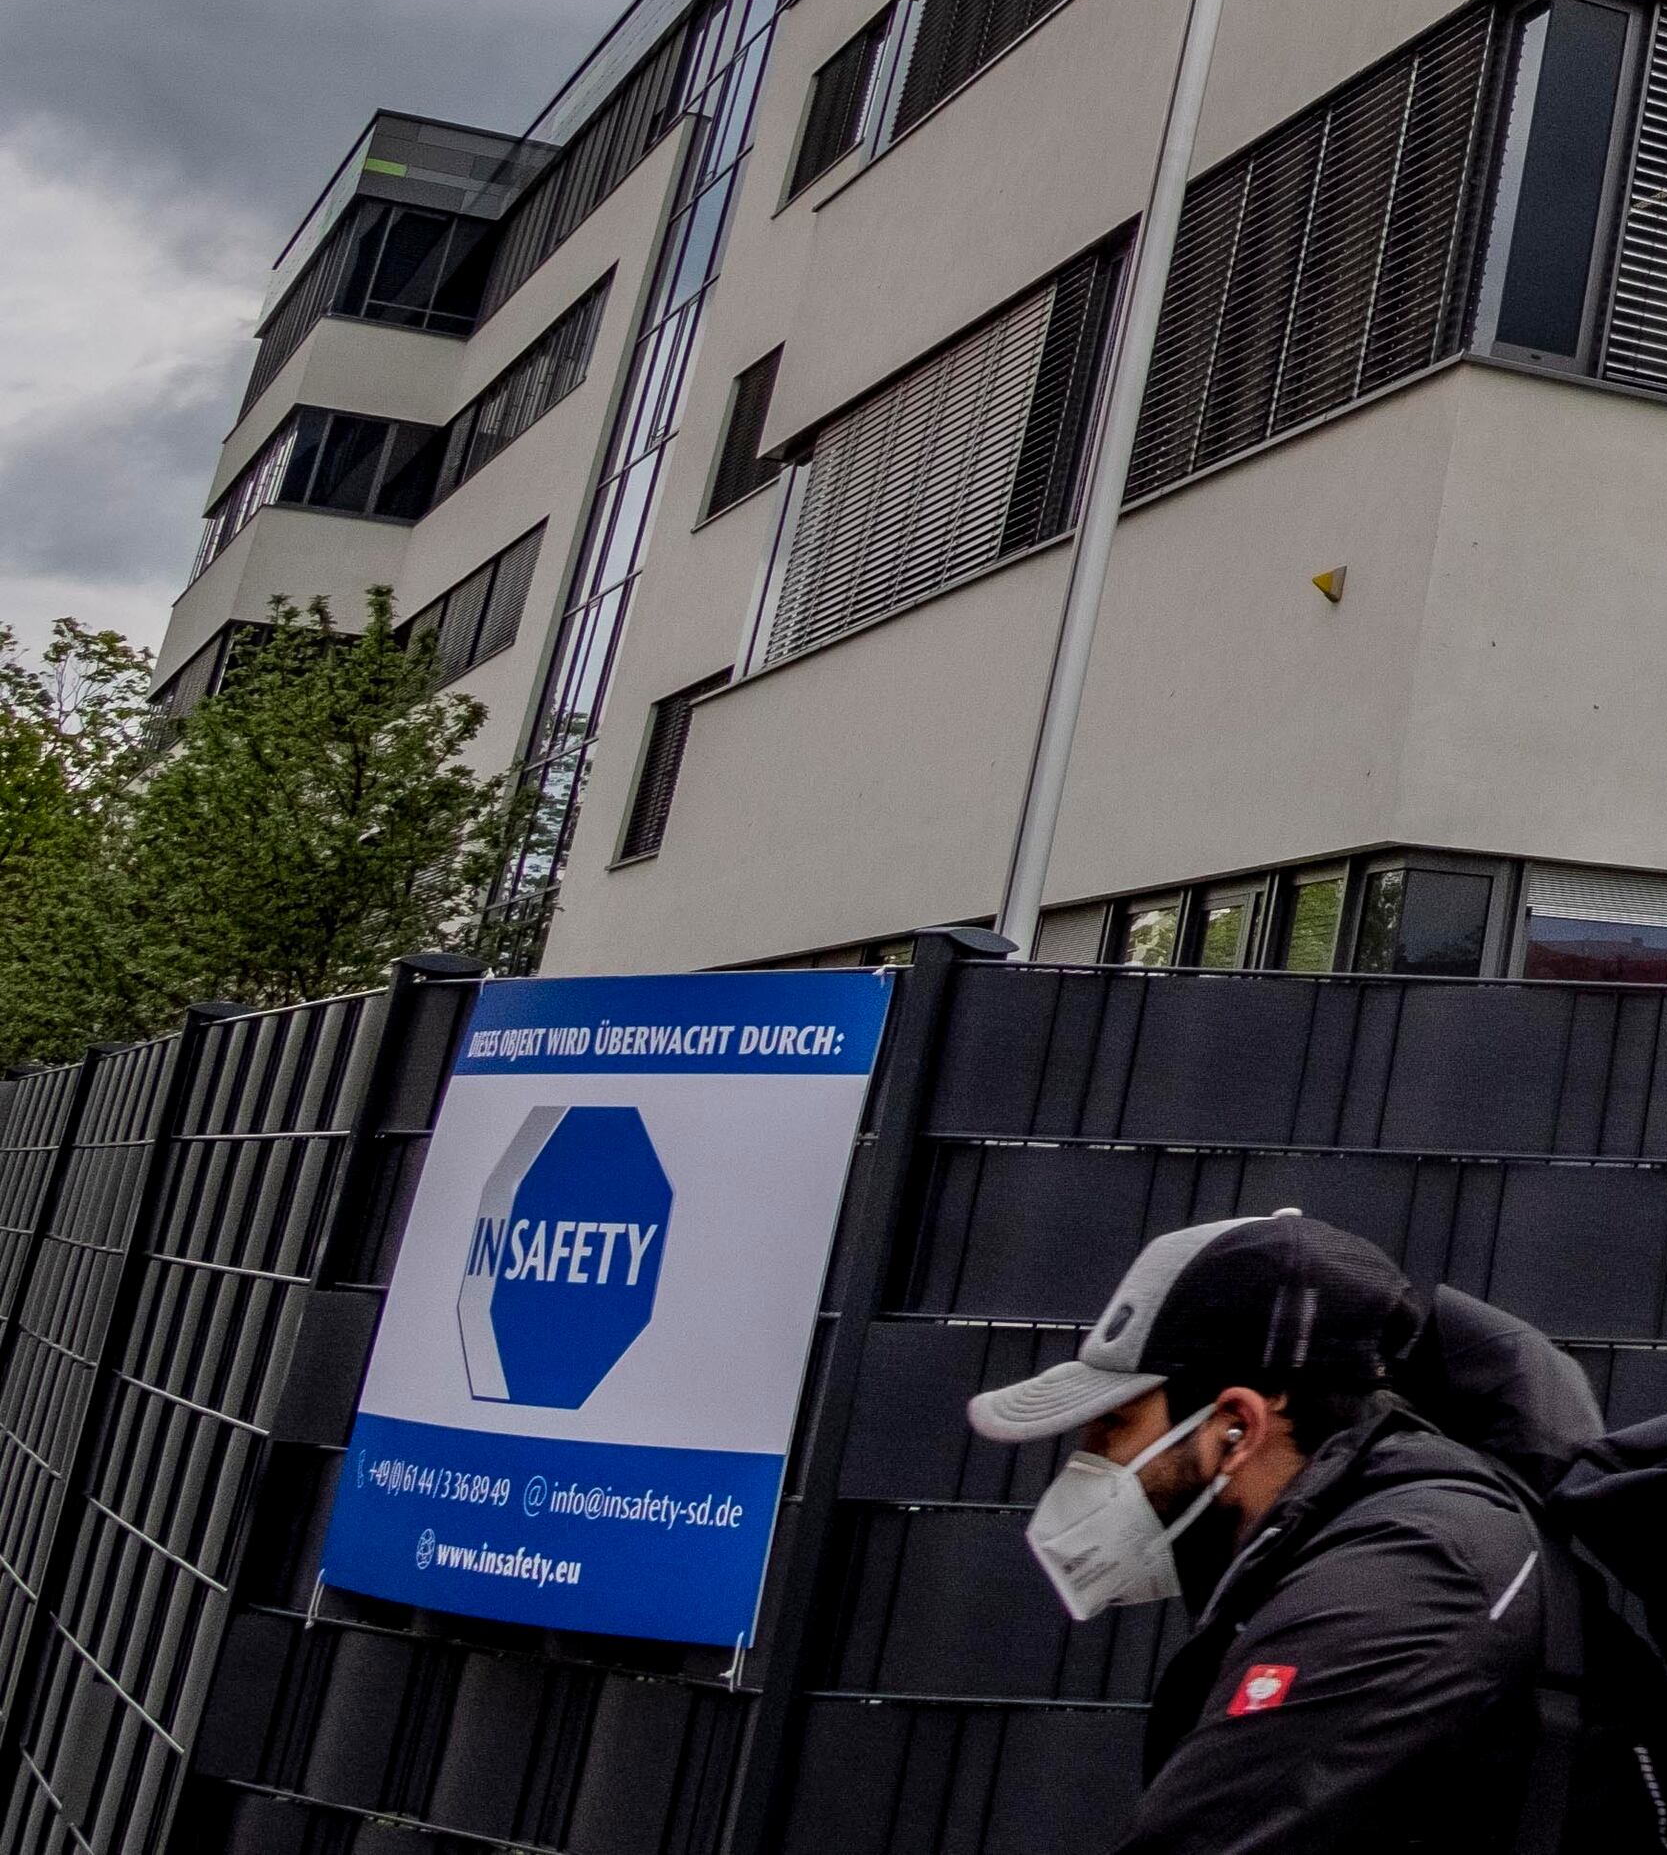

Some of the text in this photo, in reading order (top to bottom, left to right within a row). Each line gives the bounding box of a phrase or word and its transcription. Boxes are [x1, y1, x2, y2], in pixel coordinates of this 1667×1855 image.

[467, 1020, 845, 1062] DIESES OBJEKT WIRD ÜBERWACHT DURCH:
[550, 1483, 742, 1530] info@insafety-sd.de
[437, 1542, 581, 1587] www.insafety.eu
